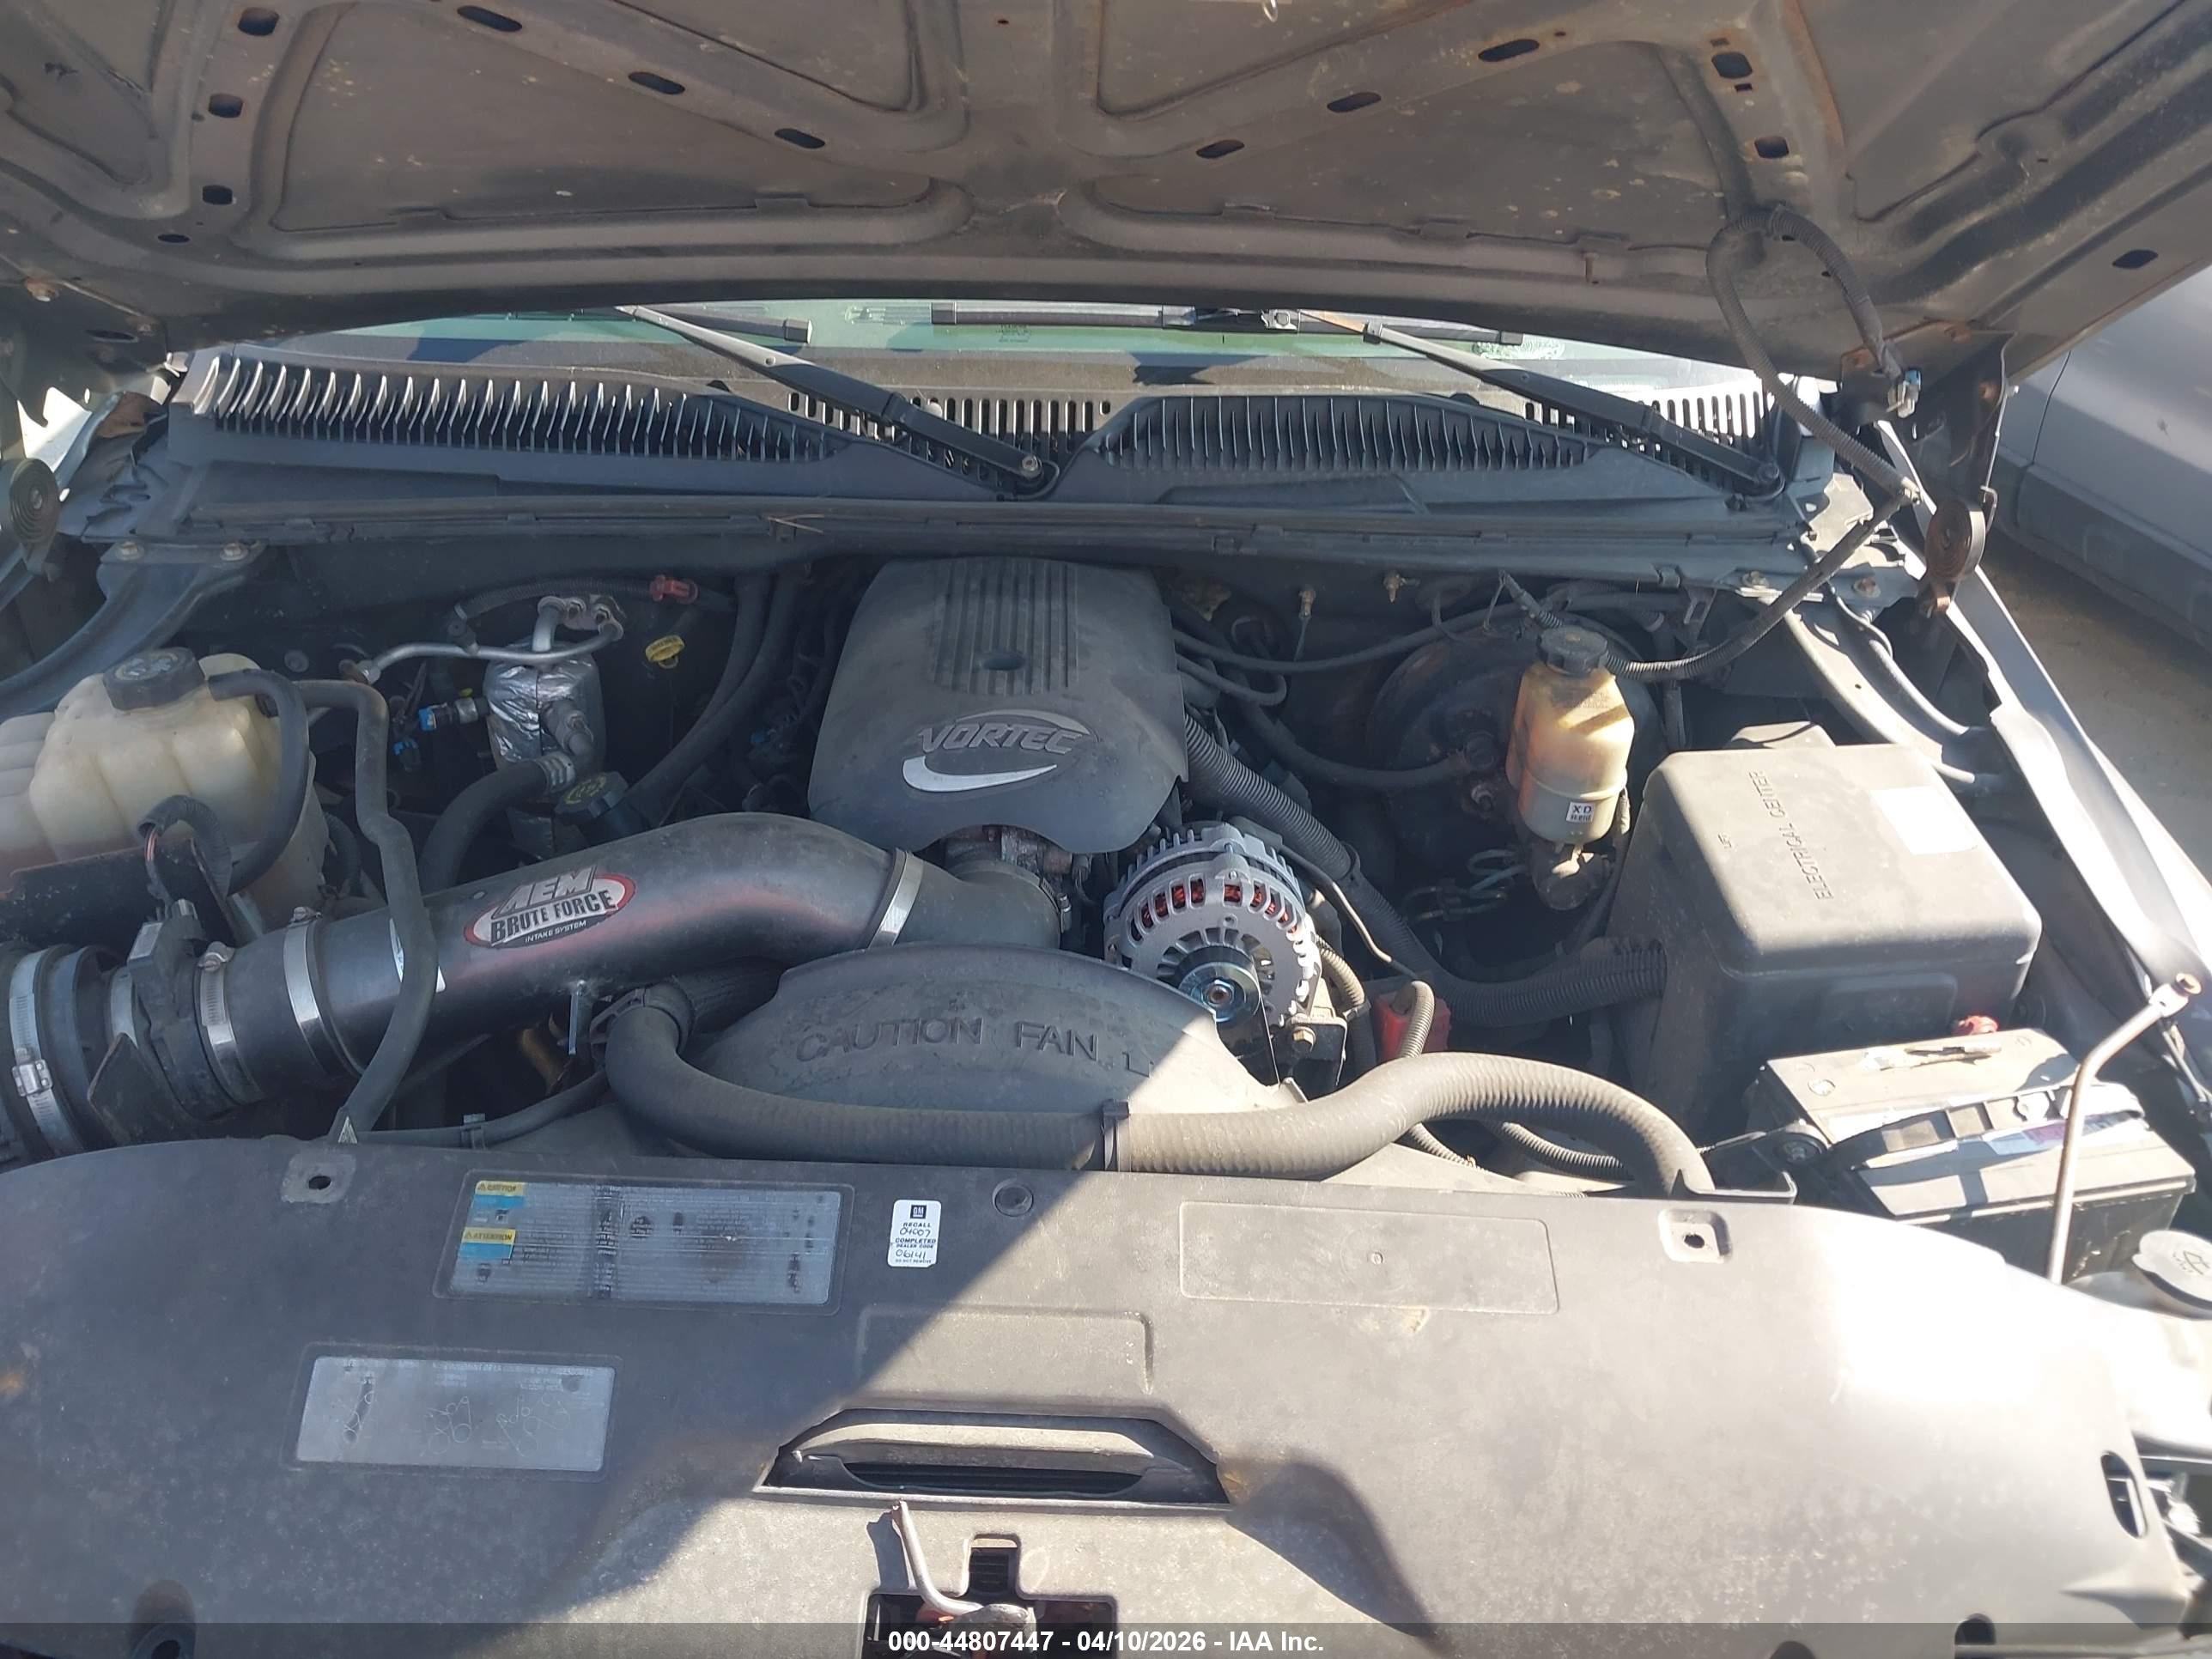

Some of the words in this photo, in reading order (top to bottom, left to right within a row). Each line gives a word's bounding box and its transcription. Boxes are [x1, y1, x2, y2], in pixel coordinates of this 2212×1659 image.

[919, 722, 1084, 755] VORTEC
[1778, 823, 1834, 900] ELECTRICAL
[491, 866, 599, 920] AEM
[491, 912, 549, 945] BRUTE
[553, 890, 617, 918] FORCE
[525, 928, 553, 944] INTAKE
[555, 920, 587, 935] SYSTEM
[796, 1017, 984, 1061] CAUTION
[1017, 1020, 1099, 1061] FAN
[912, 1206, 925, 1218] GM
